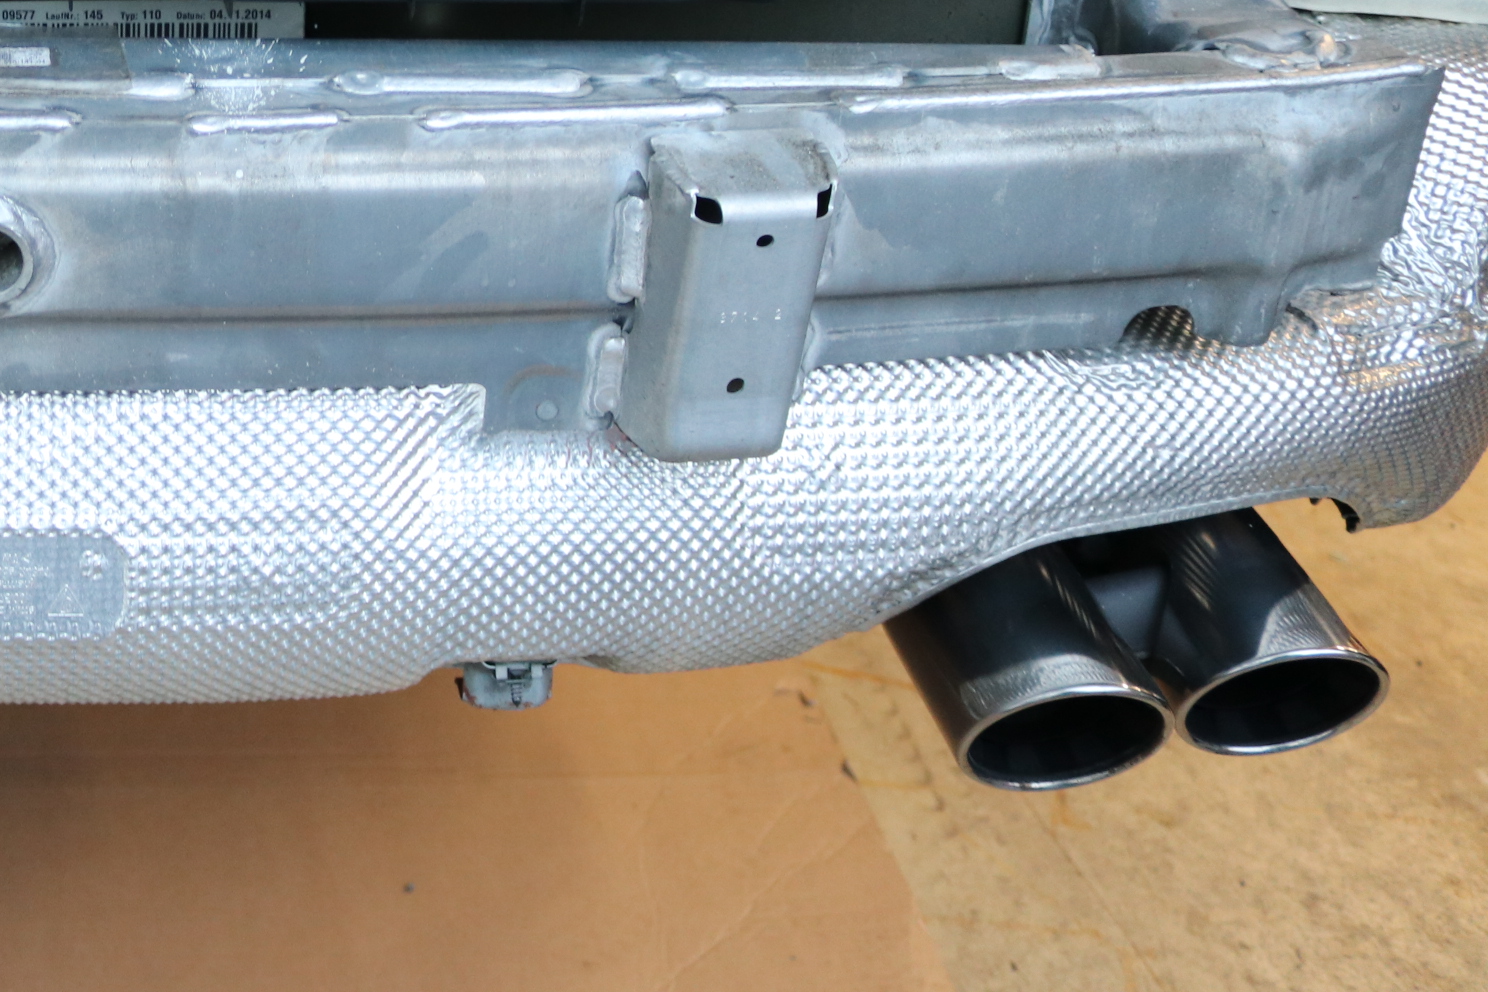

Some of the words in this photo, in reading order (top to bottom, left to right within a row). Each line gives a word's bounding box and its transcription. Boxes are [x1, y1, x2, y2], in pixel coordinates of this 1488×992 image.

[2, 10, 35, 20] 09577
[84, 10, 103, 20] 145
[121, 11, 138, 21] Typ:
[142, 10, 162, 20] 110
[176, 11, 205, 20] Datum:
[209, 9, 272, 20] 04.1.2014
